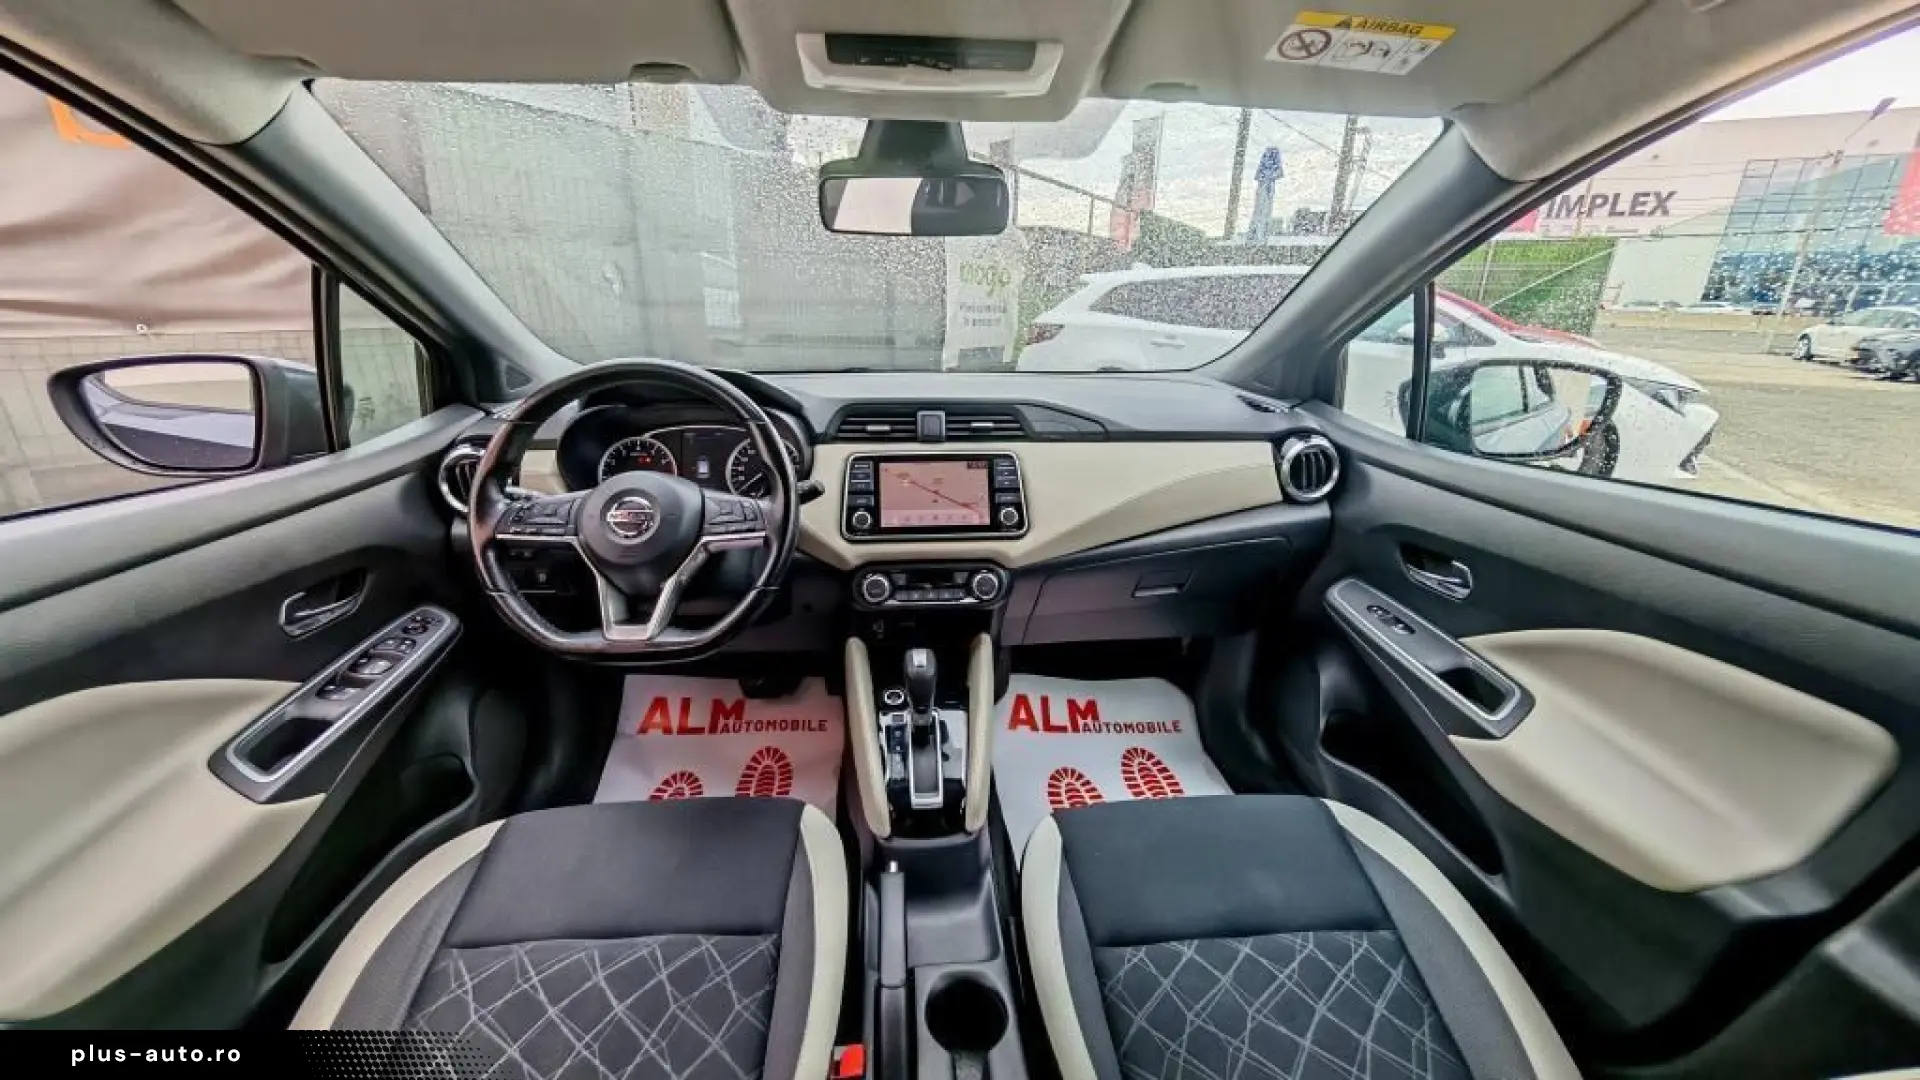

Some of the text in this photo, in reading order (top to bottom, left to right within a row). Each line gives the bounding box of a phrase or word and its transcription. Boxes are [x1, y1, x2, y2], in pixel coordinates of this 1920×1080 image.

[1356, 16, 1424, 35] AIRBAG
[1545, 190, 1678, 219] IMPLEX
[637, 696, 828, 735] ALM AUTOMOBILE
[1008, 693, 1182, 734] ALM AUTOMOBILE
